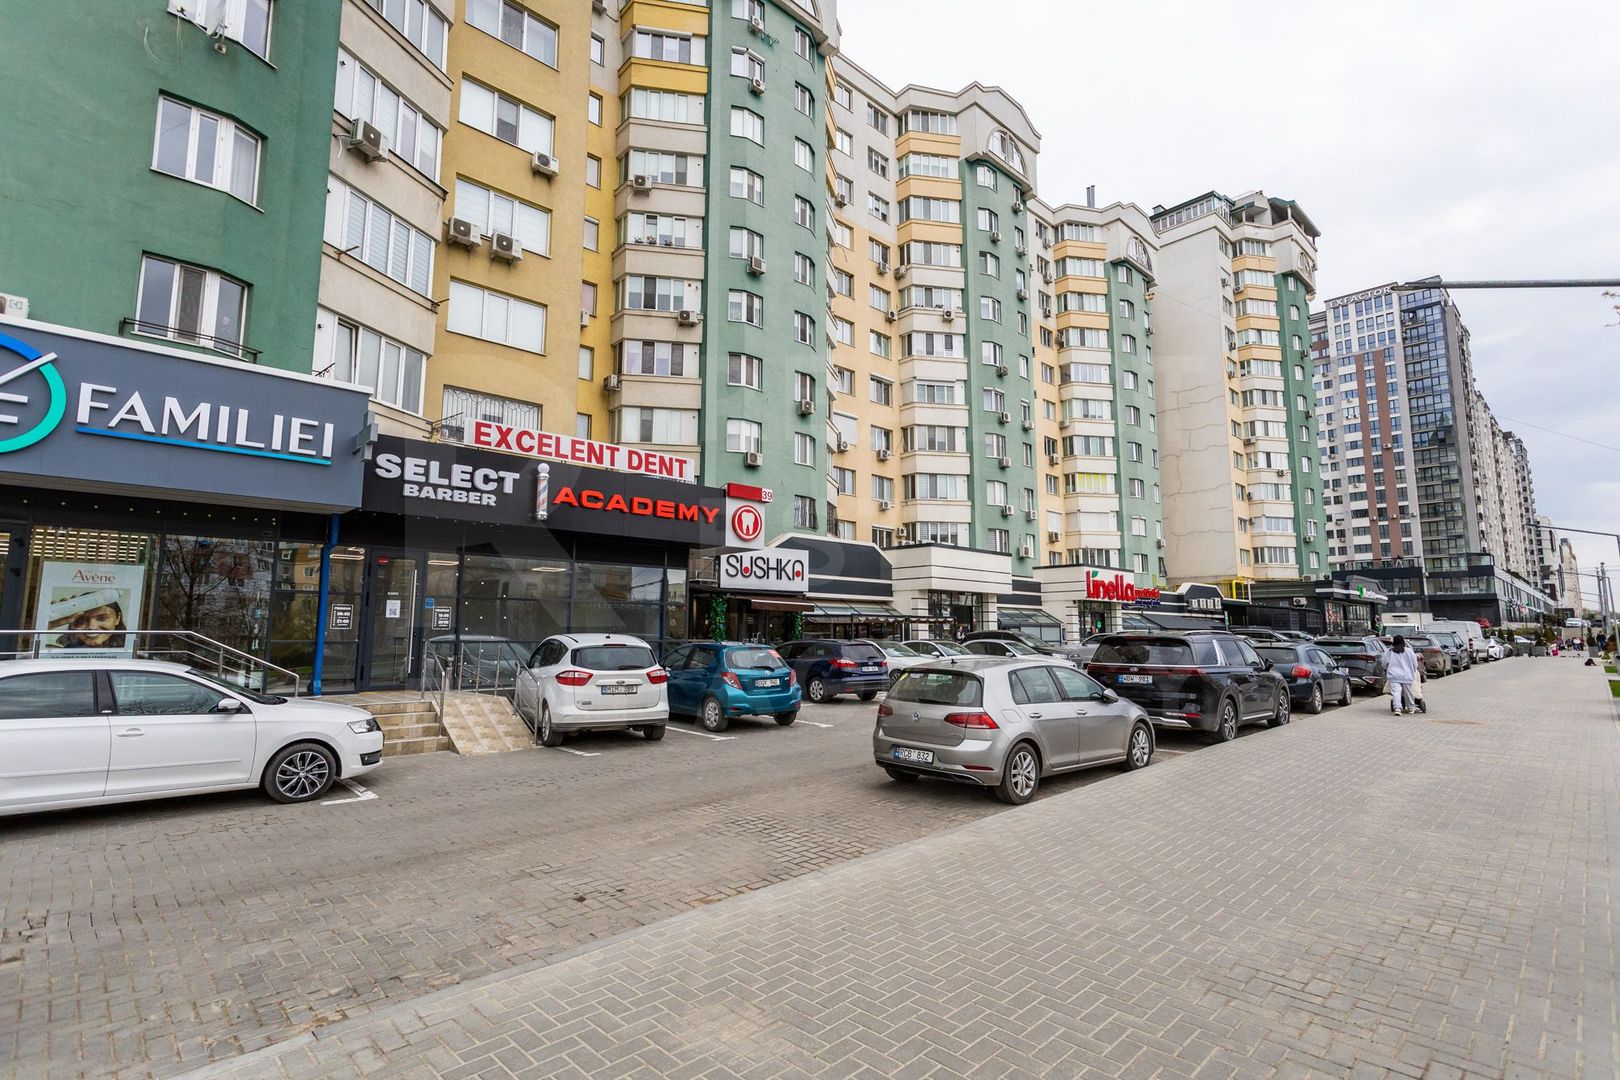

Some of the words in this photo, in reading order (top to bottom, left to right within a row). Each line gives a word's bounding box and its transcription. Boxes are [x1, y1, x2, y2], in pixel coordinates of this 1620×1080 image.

[1330, 287, 1392, 308] EXFACTOR
[76, 381, 335, 458] FAMILIEI
[475, 421, 620, 467] EXCELENT
[627, 449, 688, 478] DENT
[375, 453, 520, 494] SELECT
[403, 483, 497, 507] BARBER
[552, 486, 721, 525] ACADEMY
[761, 490, 773, 501] 39
[71, 569, 117, 583] Avène
[725, 554, 805, 582] SUSHKA
[899, 748, 913, 758] RCB
[916, 752, 930, 761] 832
